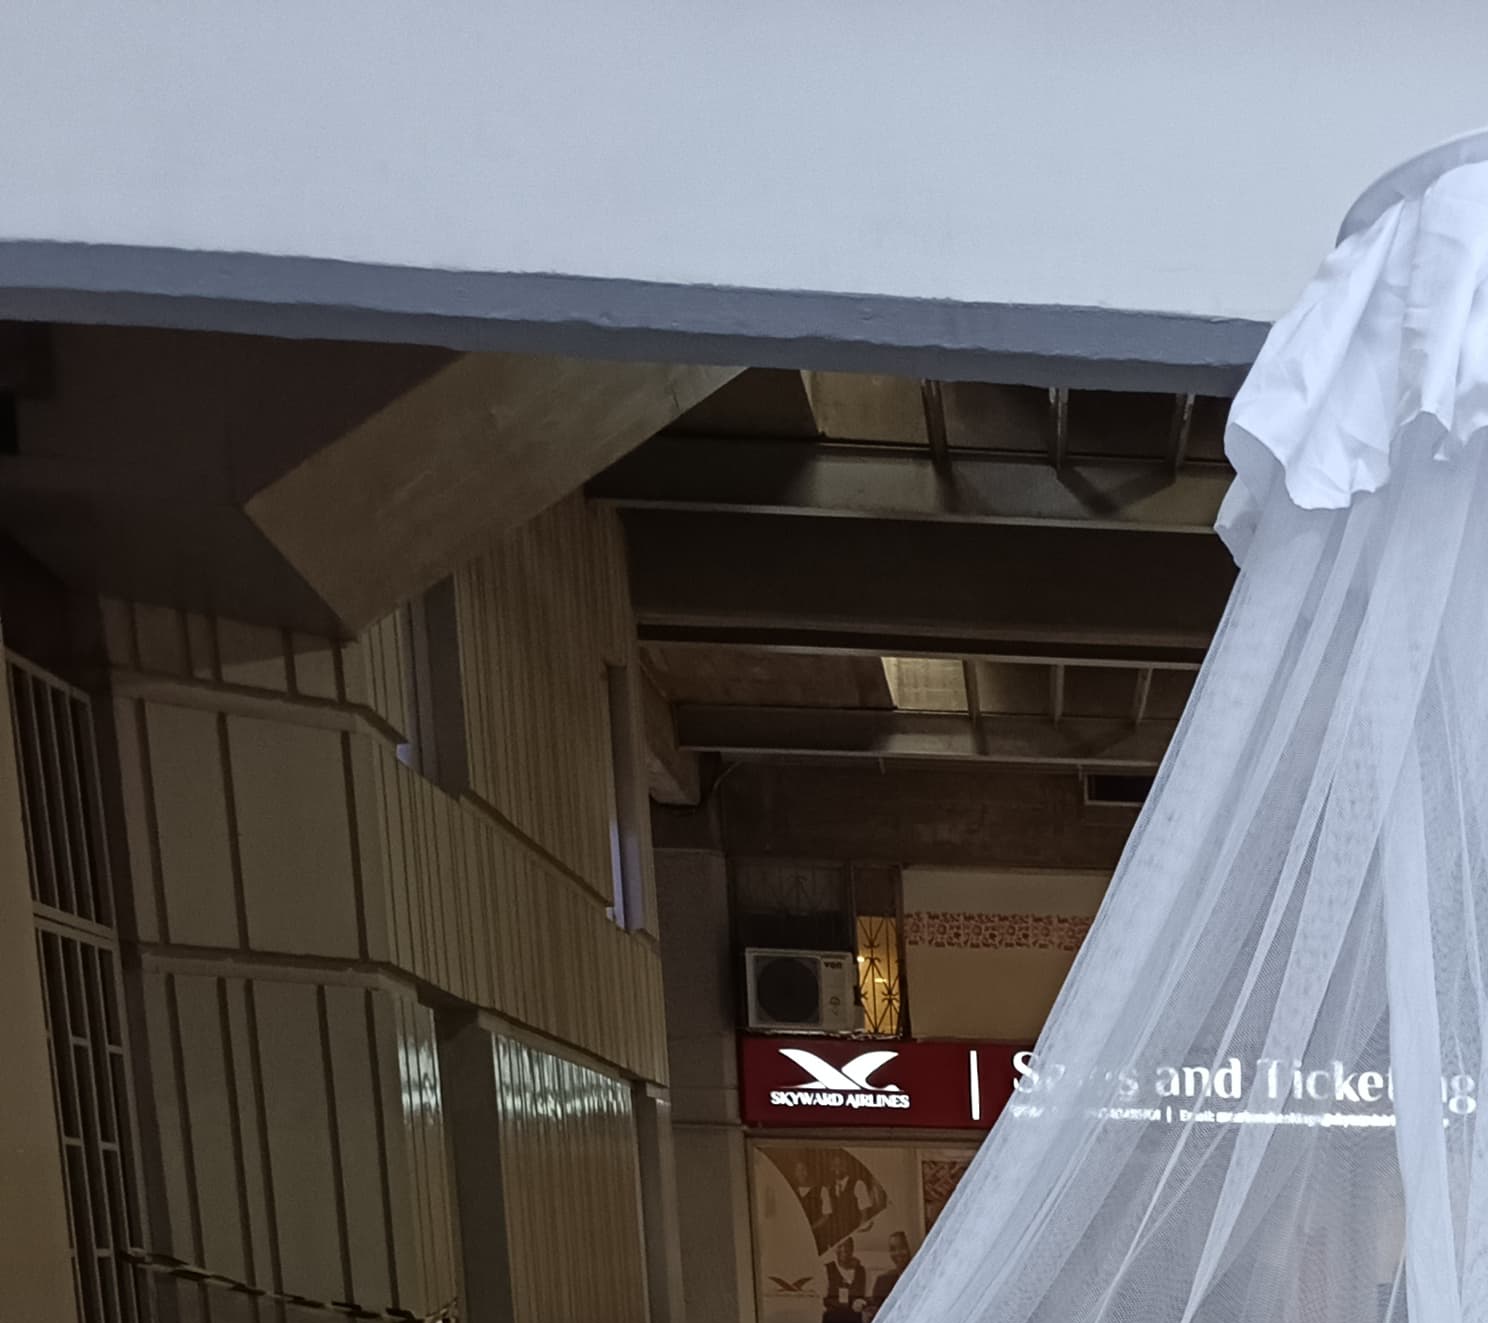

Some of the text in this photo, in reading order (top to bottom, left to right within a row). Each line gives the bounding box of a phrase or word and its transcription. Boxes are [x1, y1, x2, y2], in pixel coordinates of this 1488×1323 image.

[1155, 1057, 1242, 1099] and
[770, 1091, 910, 1109] SKYWARD AIRLINES
